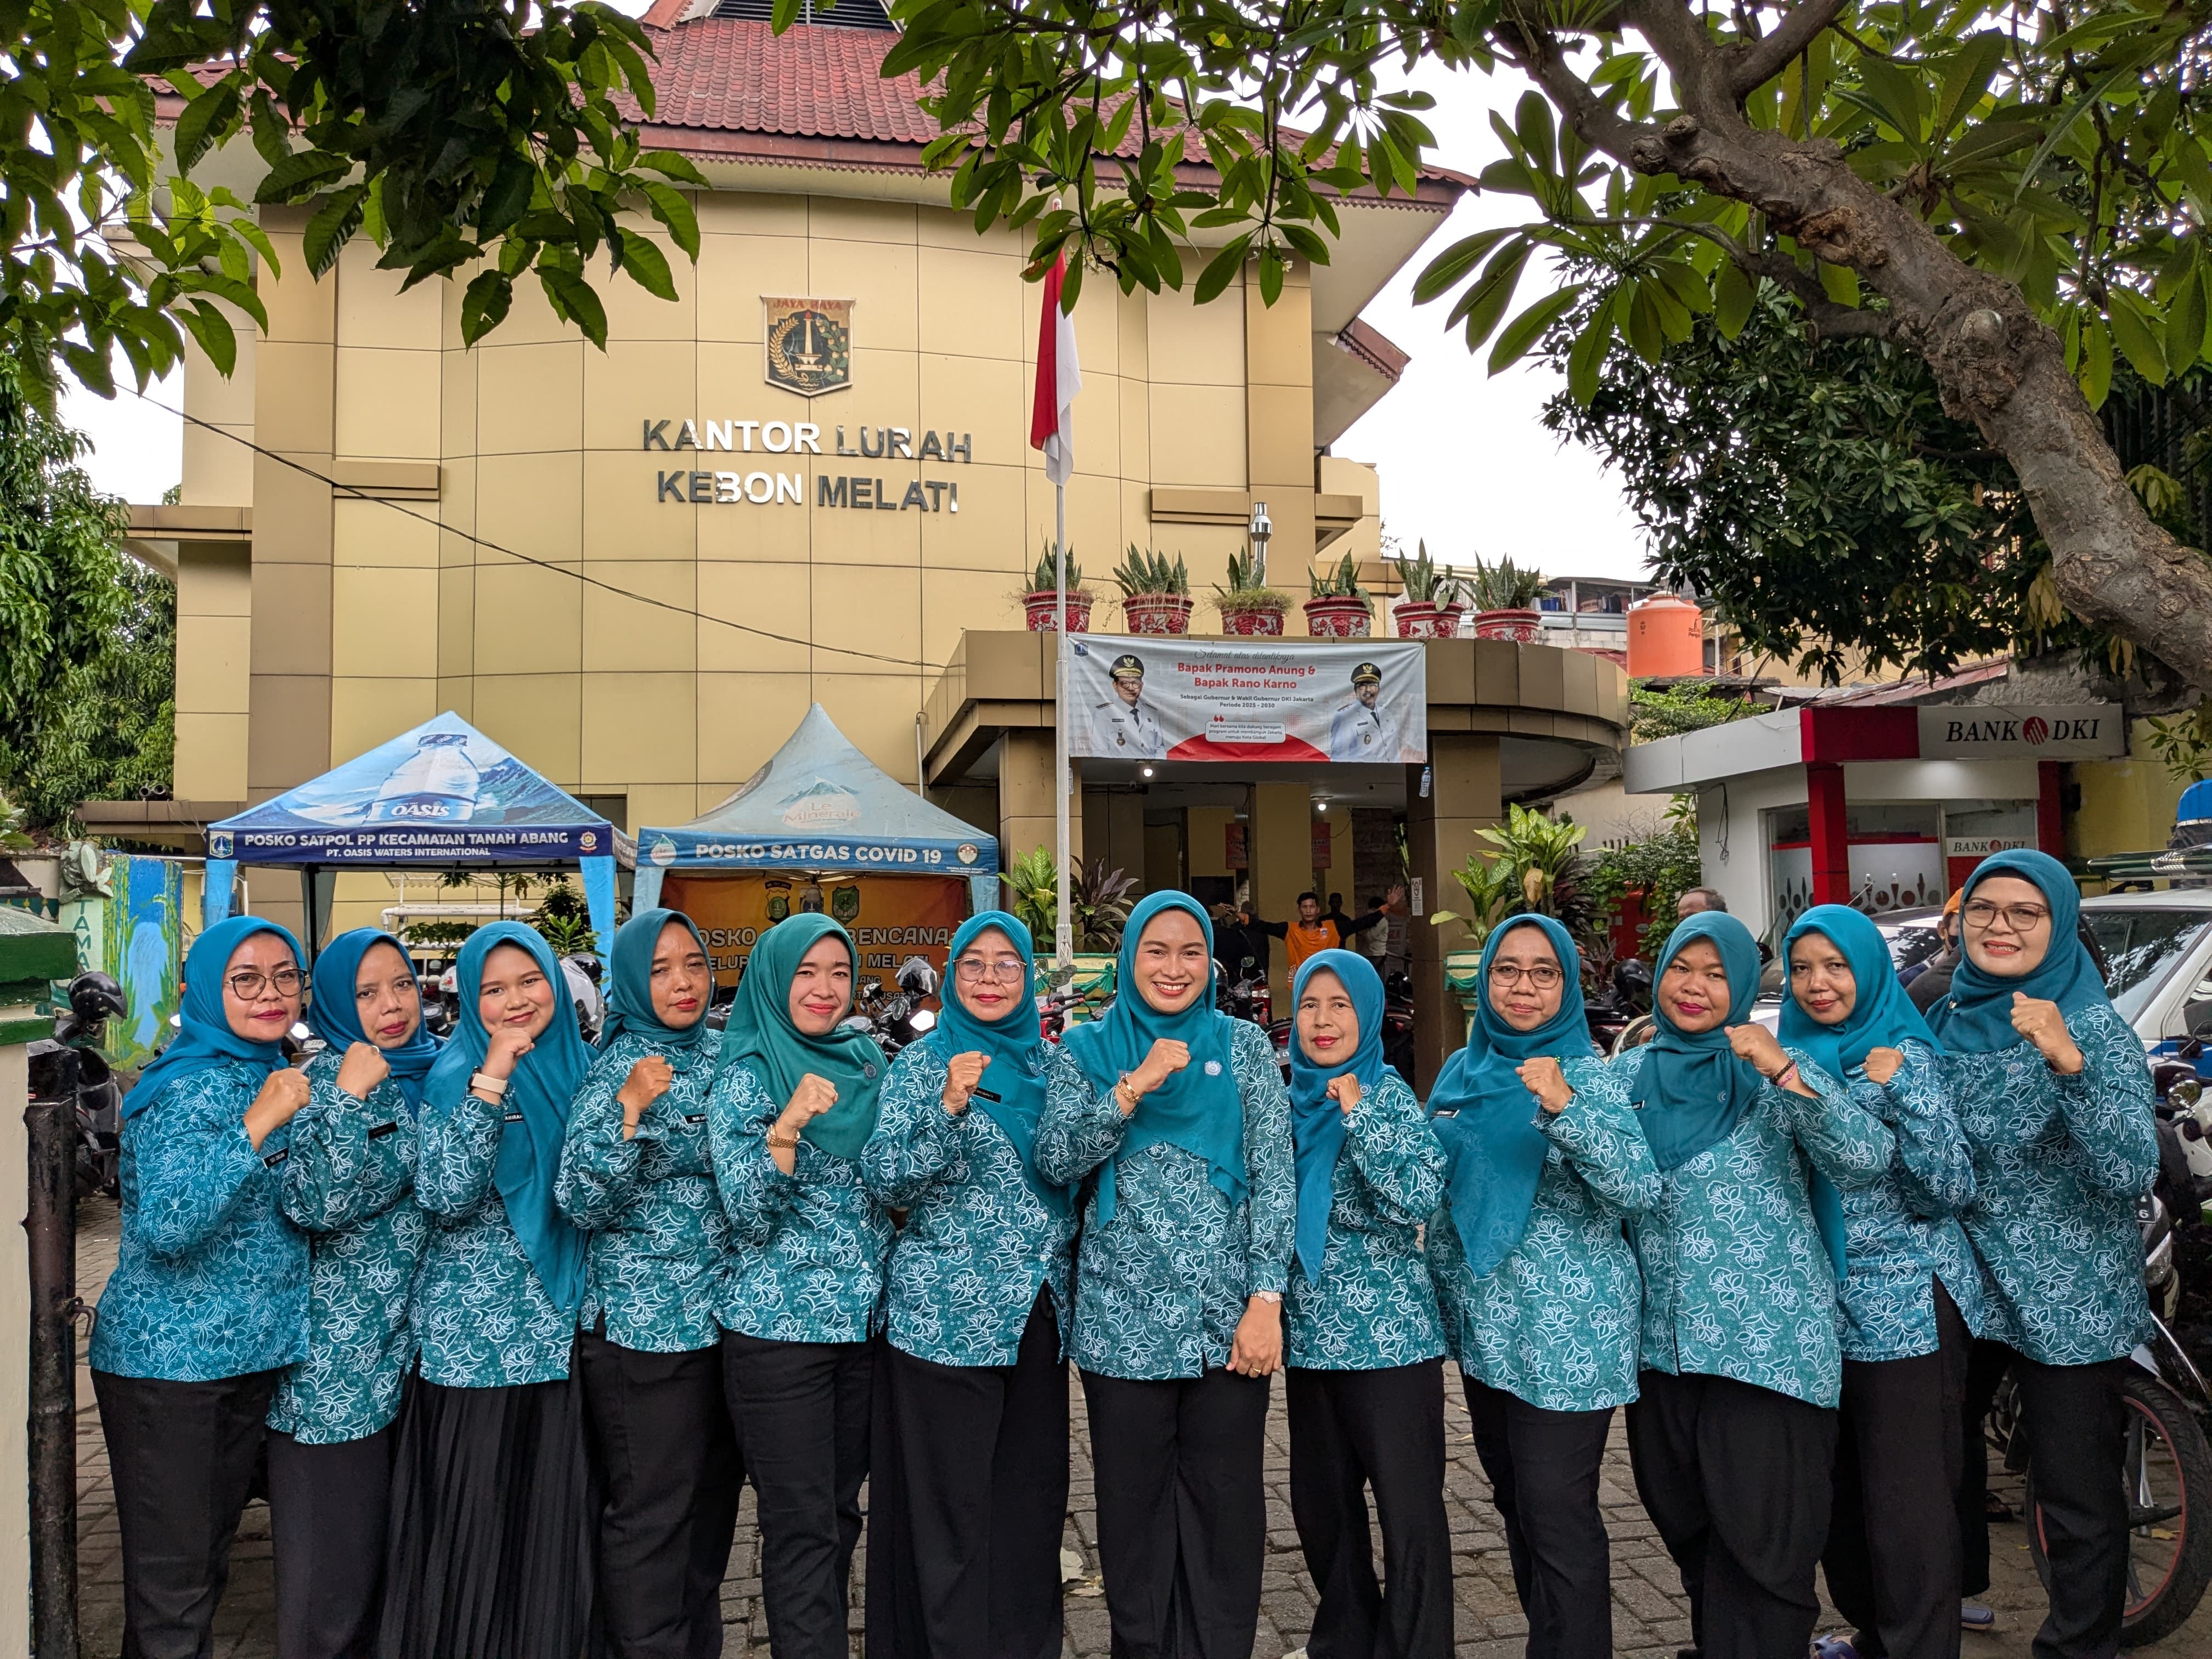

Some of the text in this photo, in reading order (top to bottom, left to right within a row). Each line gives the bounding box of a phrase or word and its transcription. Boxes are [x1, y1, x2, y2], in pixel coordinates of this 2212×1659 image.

[773, 299, 804, 308] JAYA
[643, 419, 972, 463] KANTOR LURAH
[658, 471, 958, 512] KEBON MELATI
[1194, 649, 1295, 664] Selamat atas dilantiknya
[1178, 662, 1316, 676] Bapak Pramono Anung &
[1194, 678, 1297, 689] Bapak Rano Karno
[1946, 719, 2100, 742] BANK DKI
[391, 804, 450, 817] OASIS
[811, 803, 831, 811] Le
[783, 809, 860, 822] Minerale
[245, 832, 569, 846] POSKO SATPOL PP KECAMATAN TANAH ABANG
[326, 849, 342, 857] PT.
[415, 848, 491, 856] INTERNATIONAL
[1954, 841, 2025, 852] BANK DKI
[696, 844, 942, 864] POSKO SATGAS COVID 19
